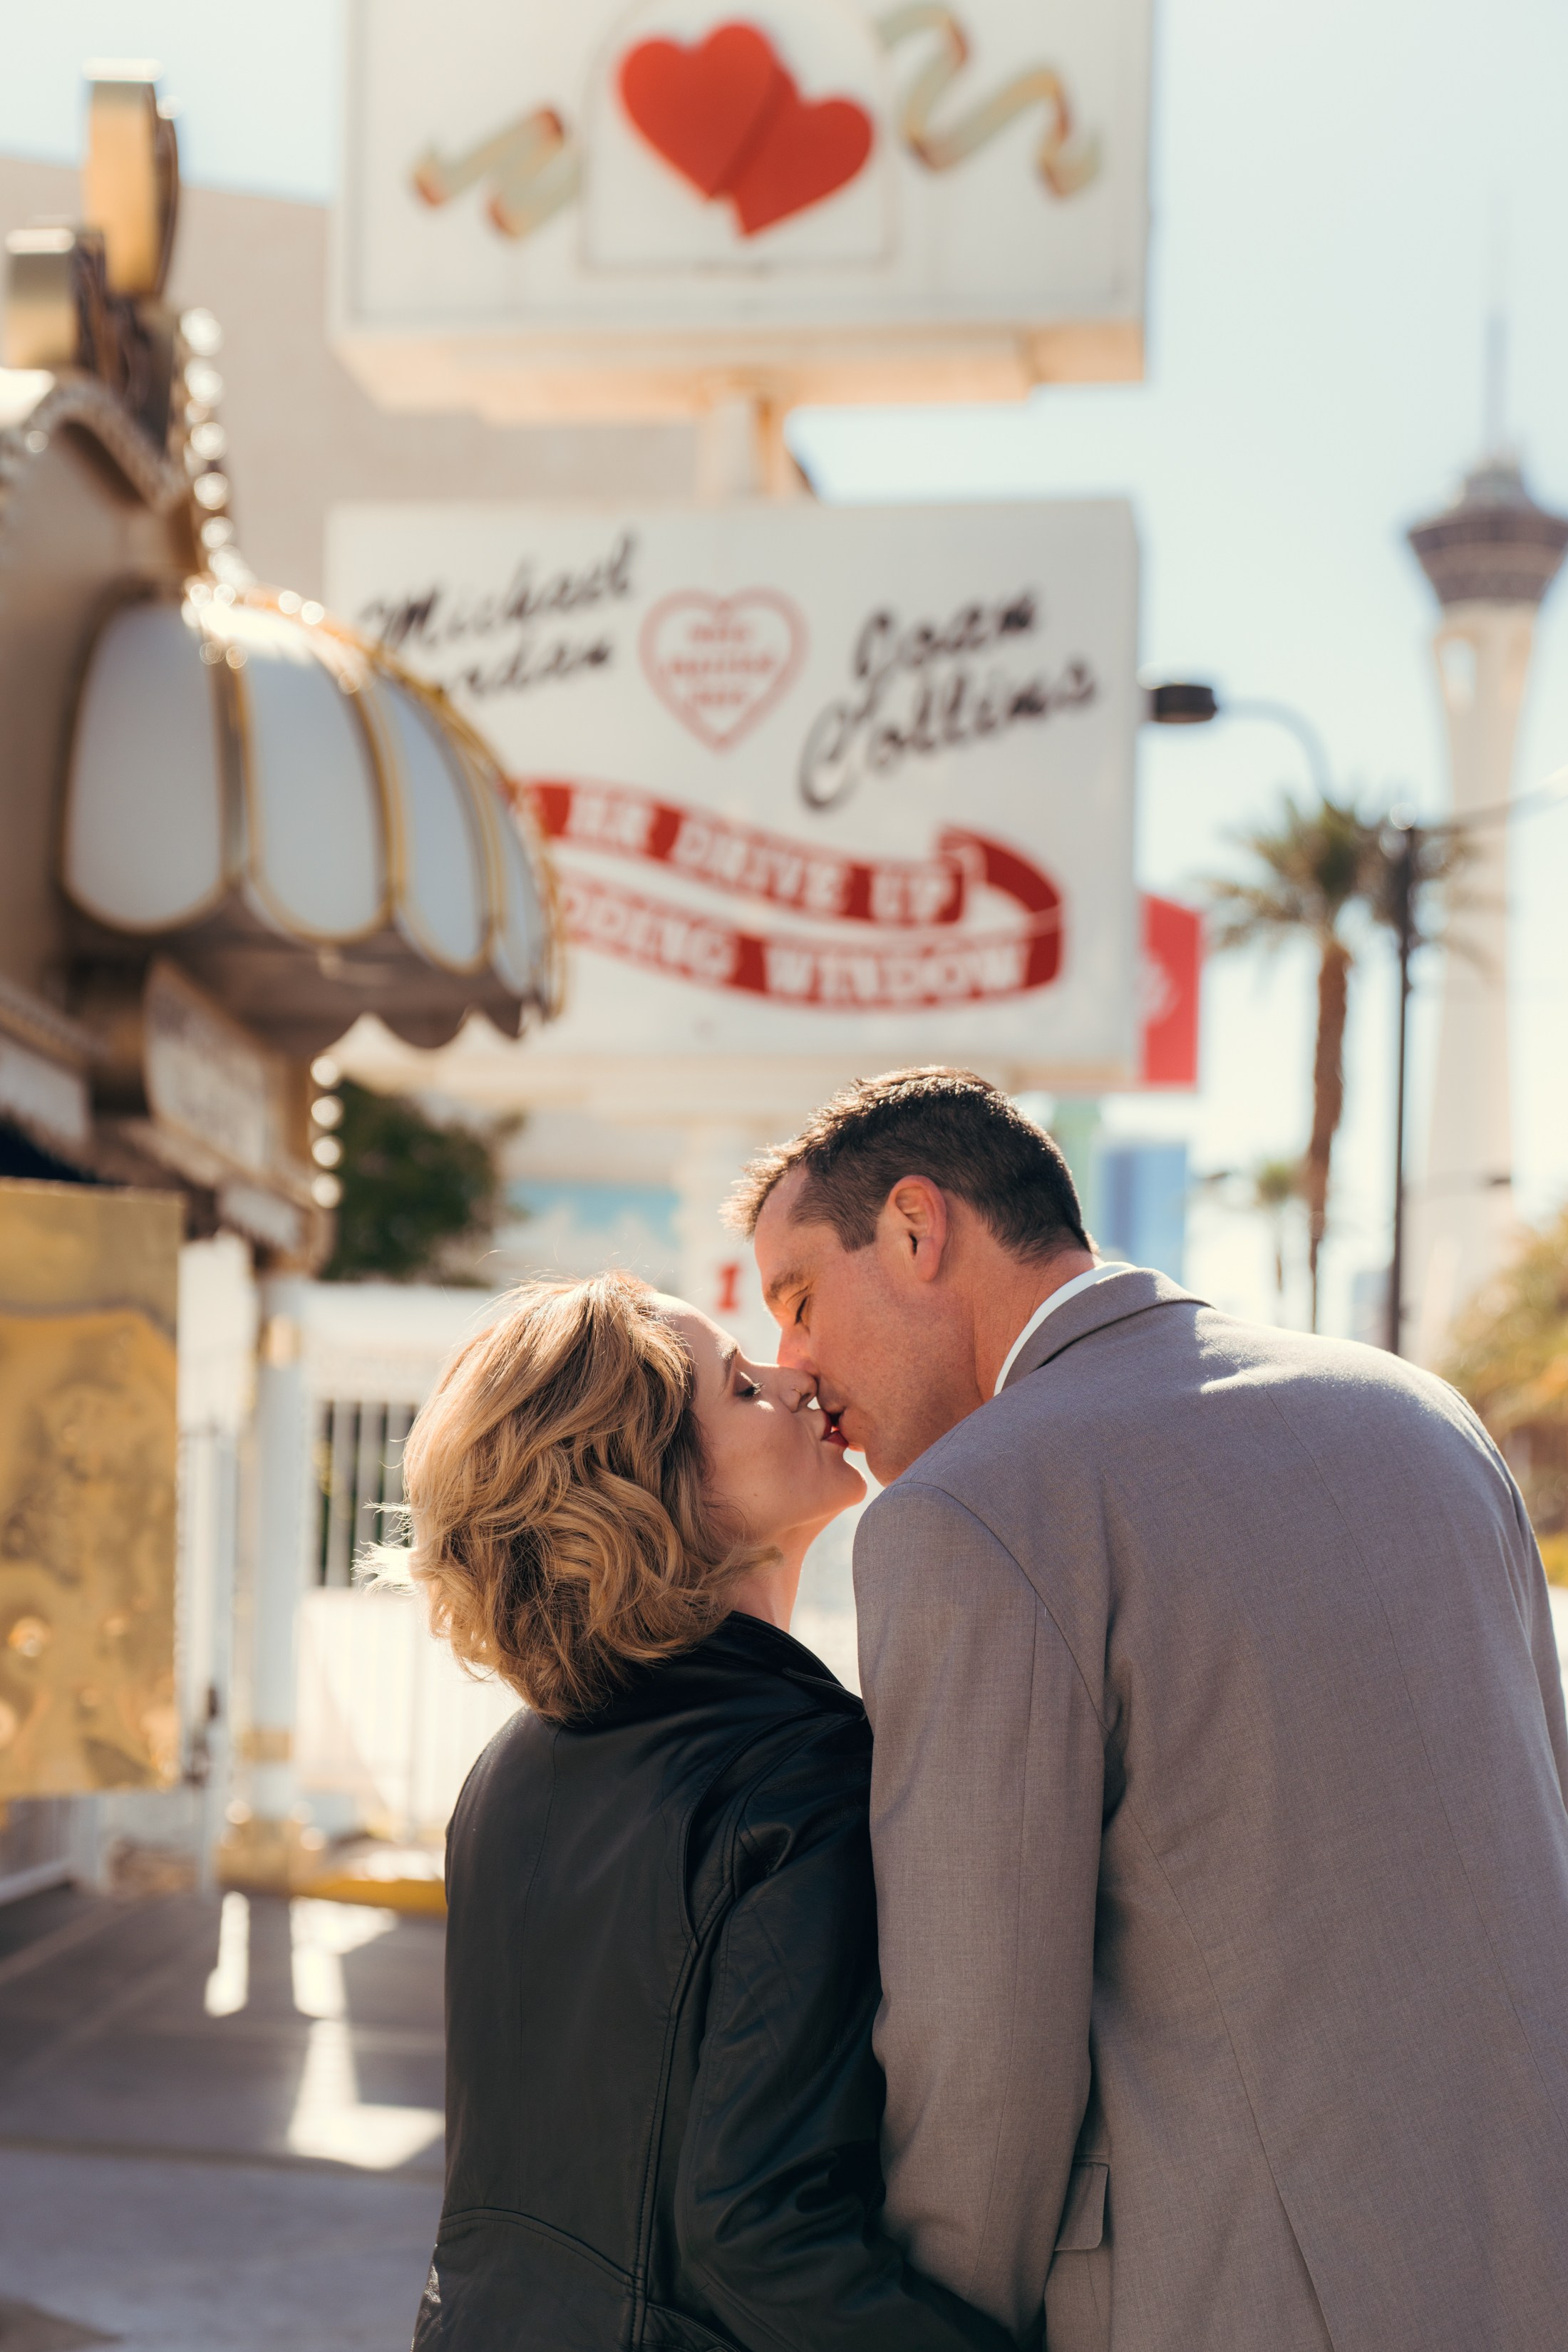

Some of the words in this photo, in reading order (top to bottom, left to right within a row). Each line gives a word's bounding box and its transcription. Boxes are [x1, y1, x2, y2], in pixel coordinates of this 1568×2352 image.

[361, 527, 637, 645] Michael
[798, 654, 1098, 813] Collins
[674, 814, 848, 911] DRIVE
[872, 867, 954, 922] UP
[767, 938, 1023, 1001] WINDOW
